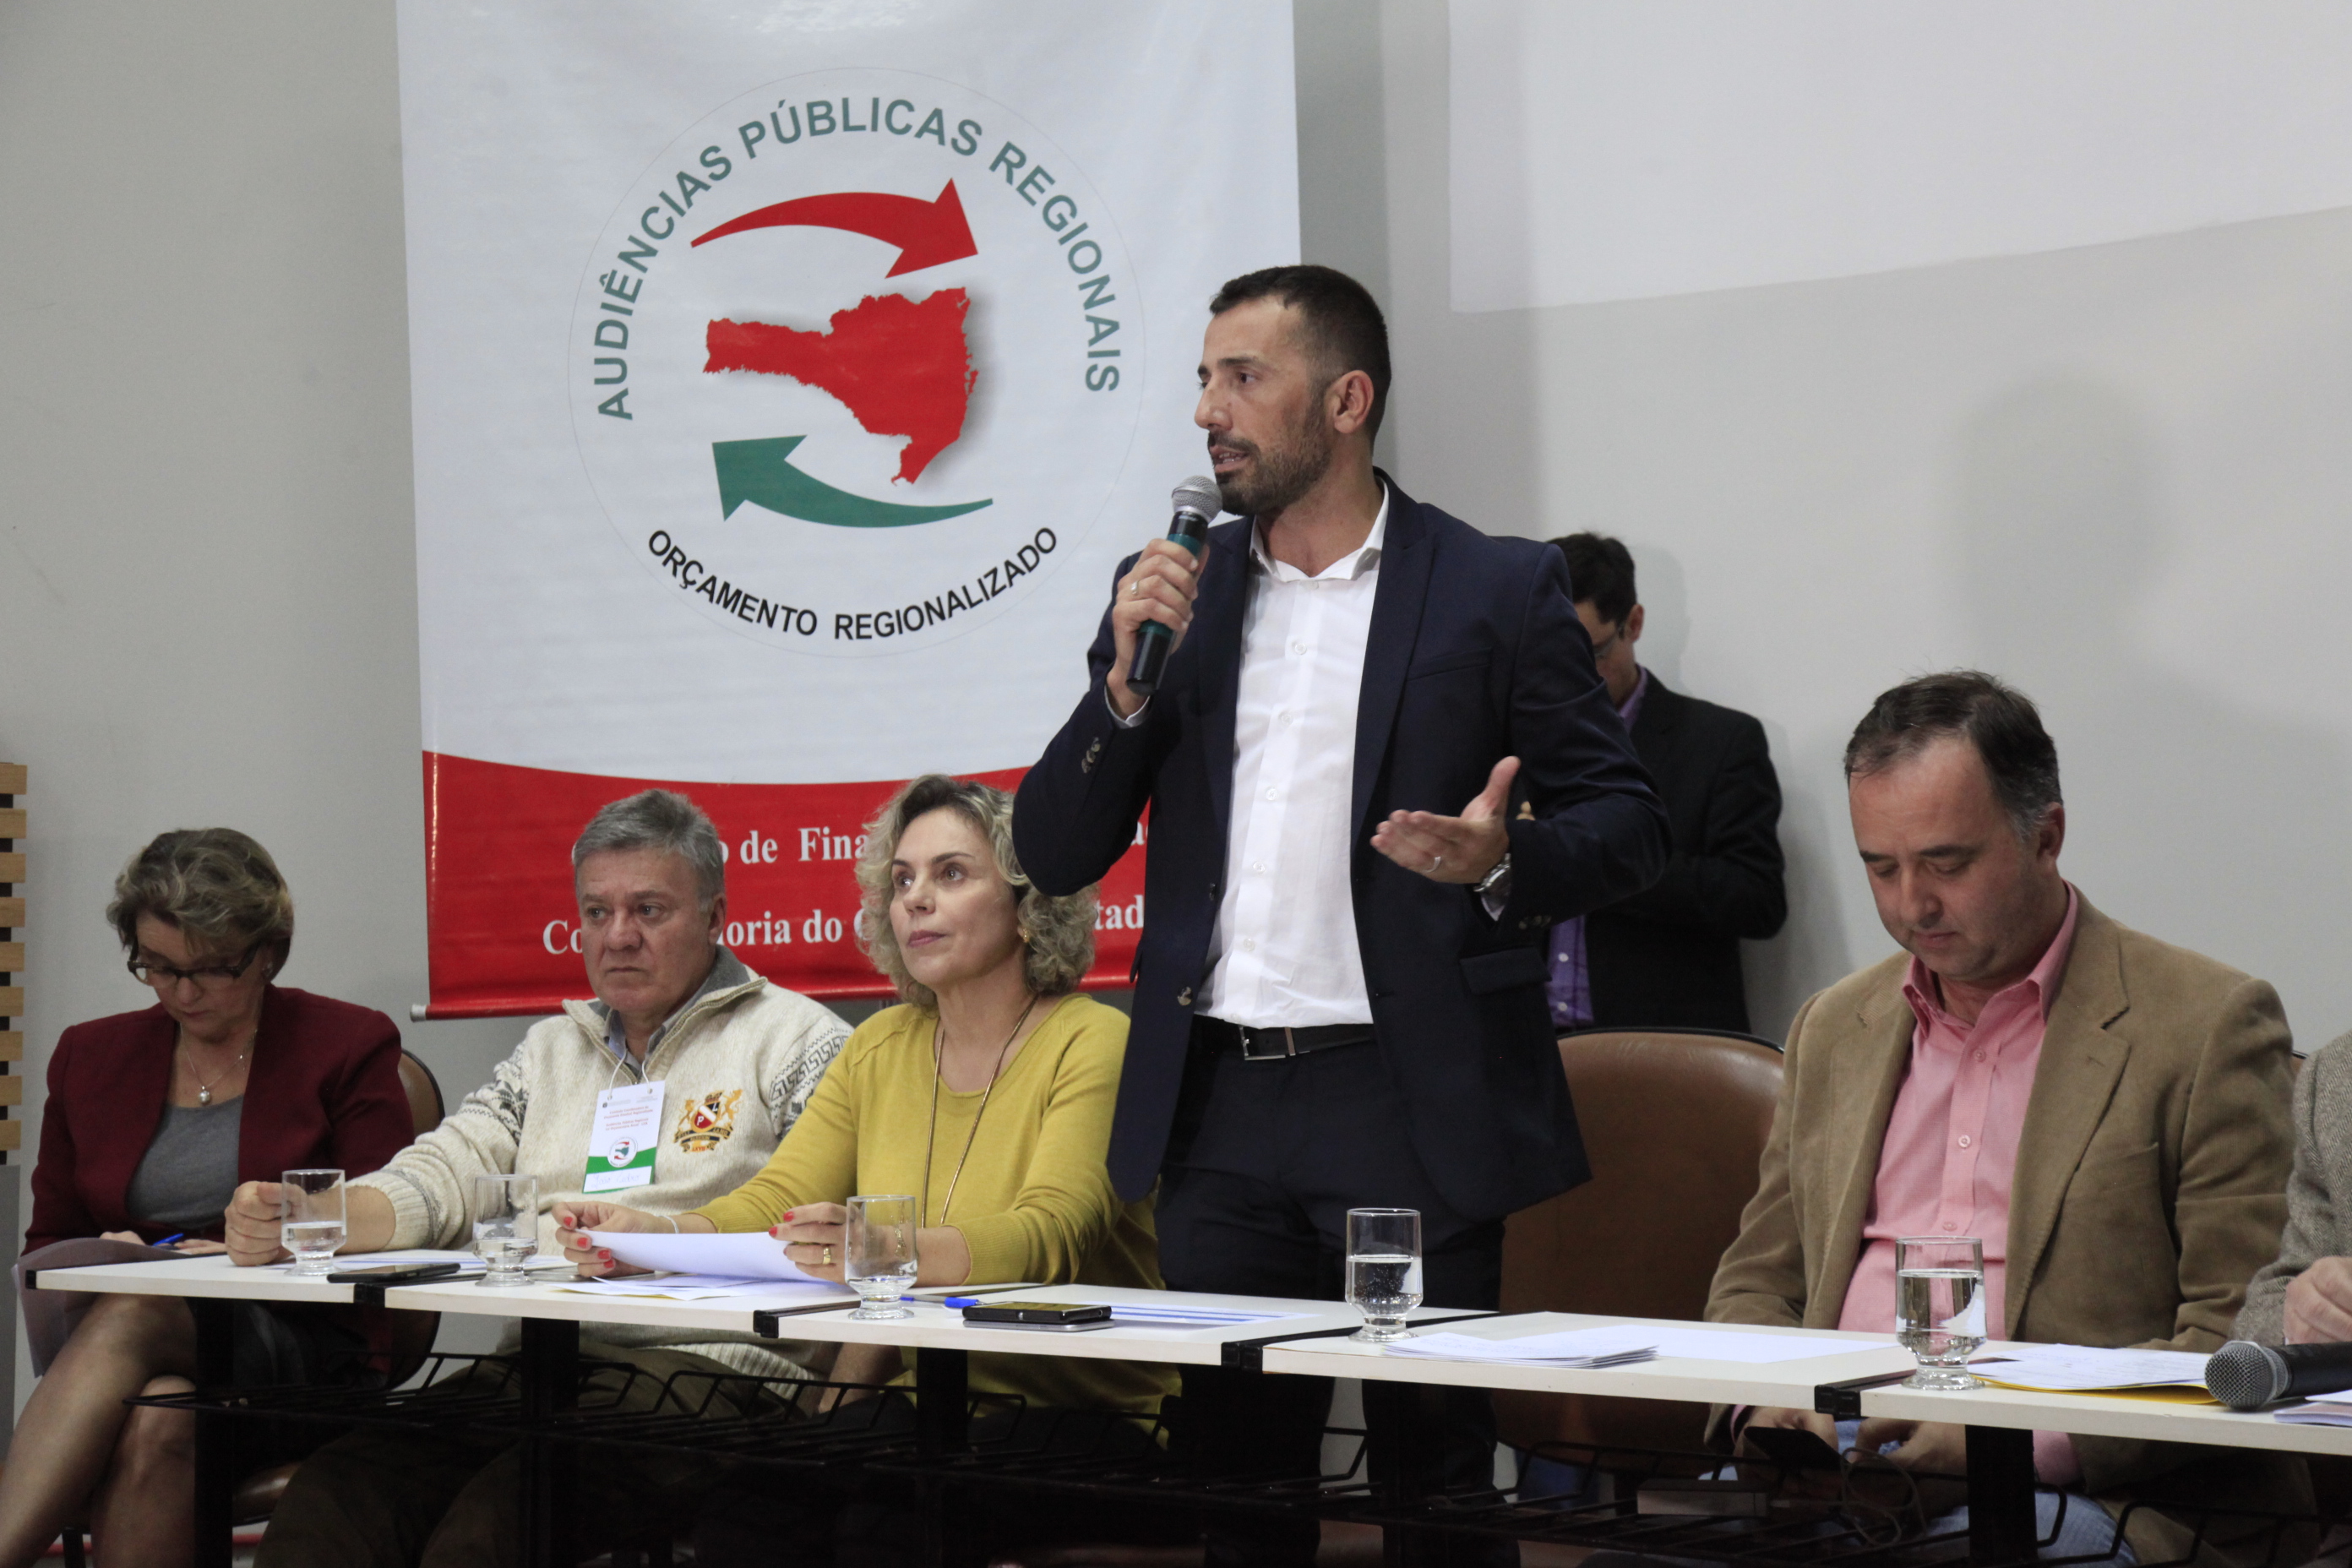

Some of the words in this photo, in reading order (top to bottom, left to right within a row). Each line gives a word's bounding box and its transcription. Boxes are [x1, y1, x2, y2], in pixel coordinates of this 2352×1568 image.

[593, 145, 732, 421] AUDIÊNCIAS
[738, 97, 983, 160] PÚBLICAS
[988, 141, 1122, 393] REGIONAIS
[648, 530, 818, 636] ORÇAMENTO
[834, 527, 1057, 640] REGIONALIZADO
[740, 830, 778, 864] de
[798, 826, 870, 862] Fina
[803, 909, 843, 944] do
